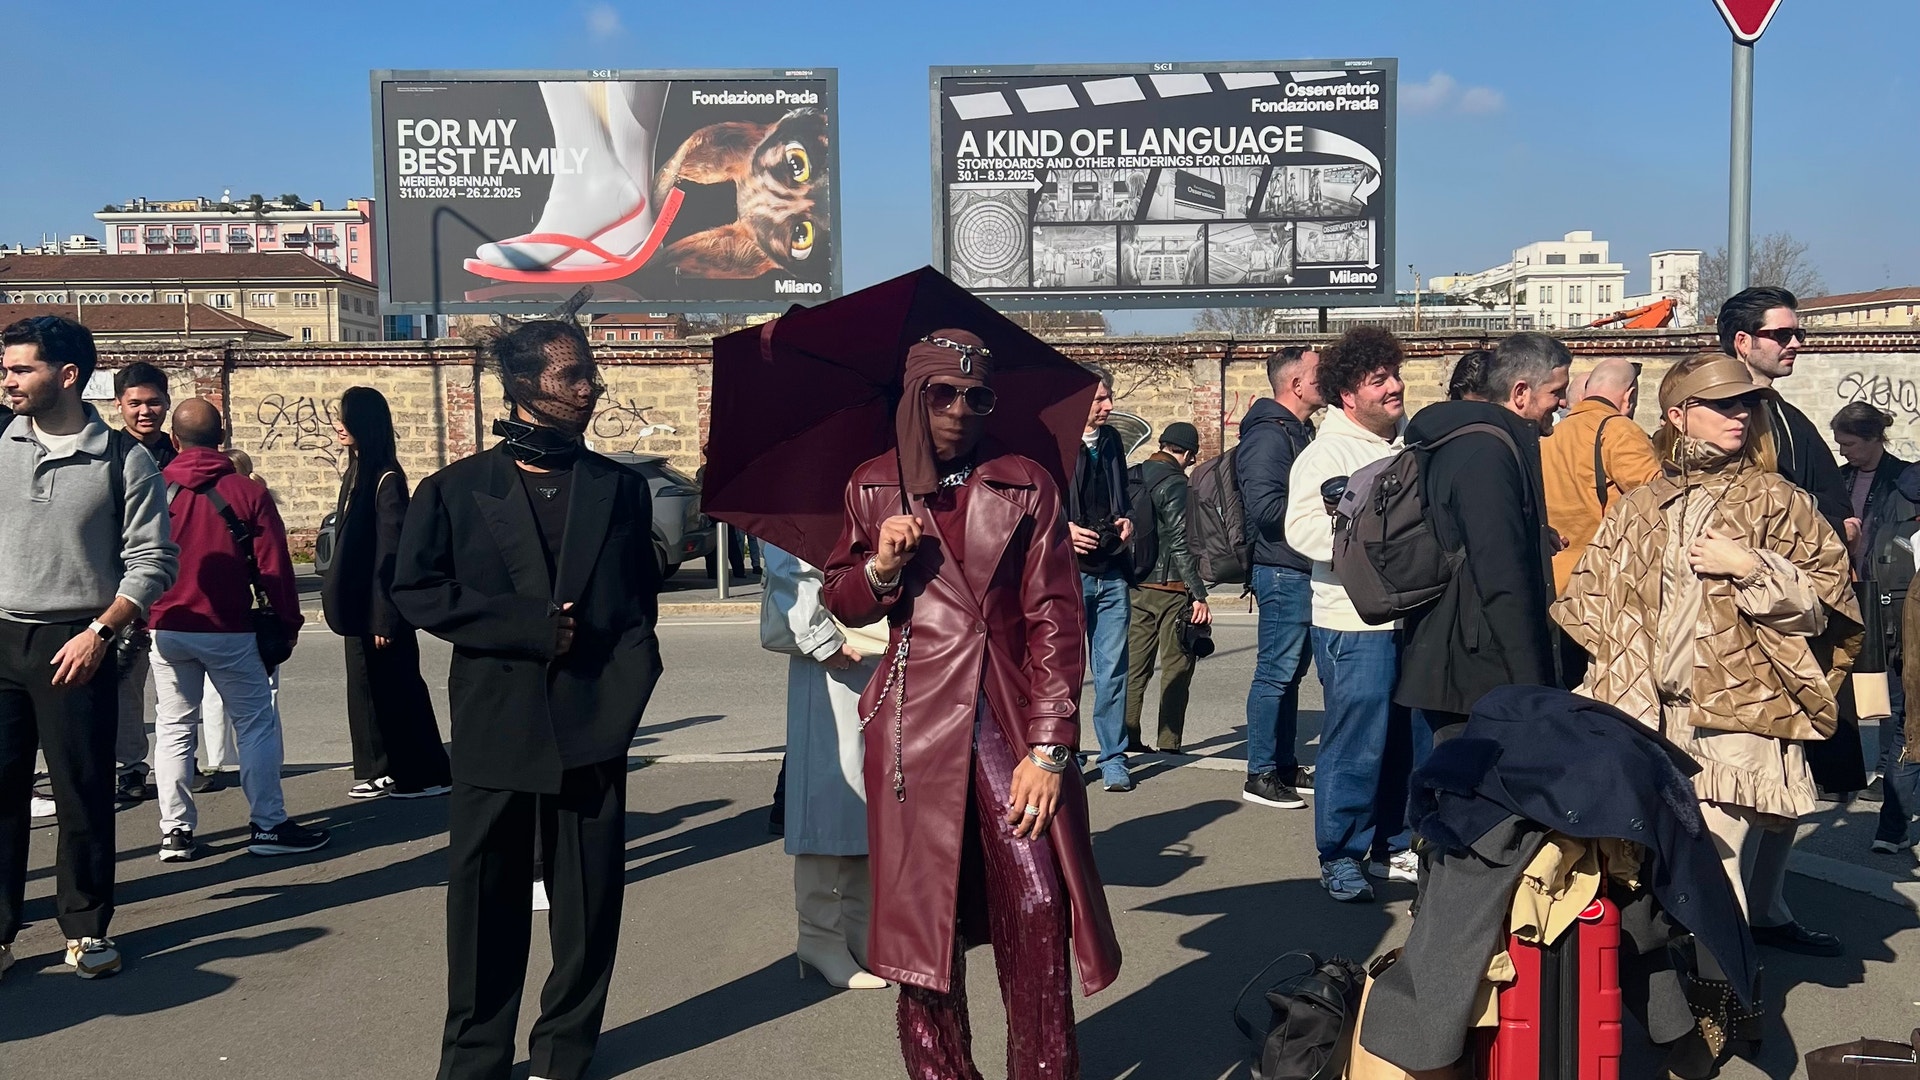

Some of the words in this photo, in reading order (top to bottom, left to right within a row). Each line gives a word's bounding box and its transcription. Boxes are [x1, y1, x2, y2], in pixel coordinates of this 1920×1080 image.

[692, 90, 774, 105] Fondazione
[776, 89, 818, 104] Prada
[1285, 81, 1380, 97] Osservatorio
[1251, 98, 1335, 113] Fondazione
[1336, 96, 1379, 111] Prada
[397, 119, 462, 147] FOR
[468, 119, 517, 146] MY
[956, 130, 981, 158] A
[987, 129, 1064, 158] KIND
[1070, 128, 1114, 157] OF
[1120, 125, 1303, 156] LANGUAGE
[398, 148, 476, 175] BEST
[483, 147, 589, 175] FAMILY
[957, 158, 1044, 170] STORYBOARDS
[1046, 157, 1073, 169] AND
[1075, 156, 1115, 168] OTHER
[1117, 155, 1193, 168] RENDERINGS
[1195, 155, 1220, 166] FOR
[1222, 154, 1271, 166] CINEMA
[399, 176, 446, 187] MERIEM
[449, 176, 502, 187] BENNANI
[1329, 270, 1378, 284] Milano
[775, 279, 823, 293] Milano
[255, 832, 278, 841] HOKA
